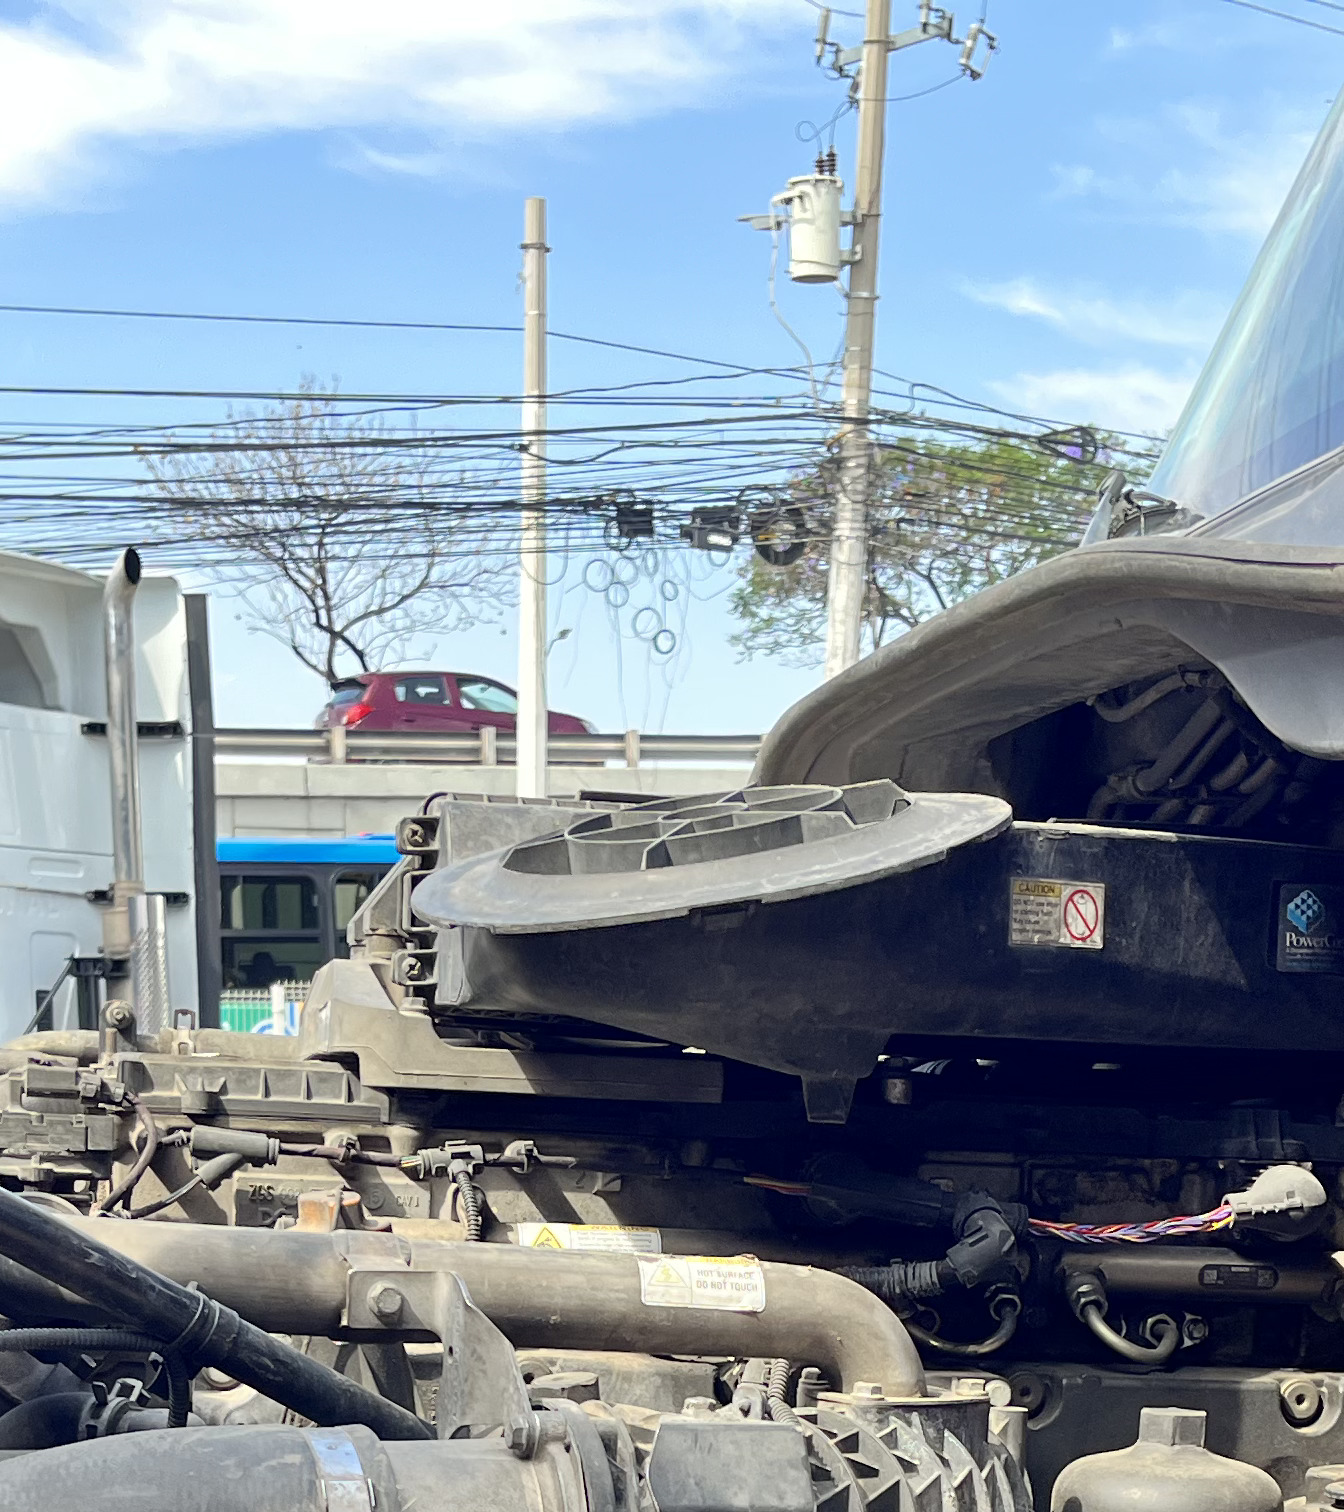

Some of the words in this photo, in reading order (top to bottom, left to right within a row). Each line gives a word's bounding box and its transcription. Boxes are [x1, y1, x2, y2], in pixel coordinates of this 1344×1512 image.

[1018, 883, 1056, 895] CAUTION
[697, 1269, 714, 1278] HOT
[716, 1270, 755, 1281] SURFACE
[696, 1280, 708, 1289] DO
[711, 1281, 728, 1290] NOT
[730, 1282, 758, 1292] TOUCH
